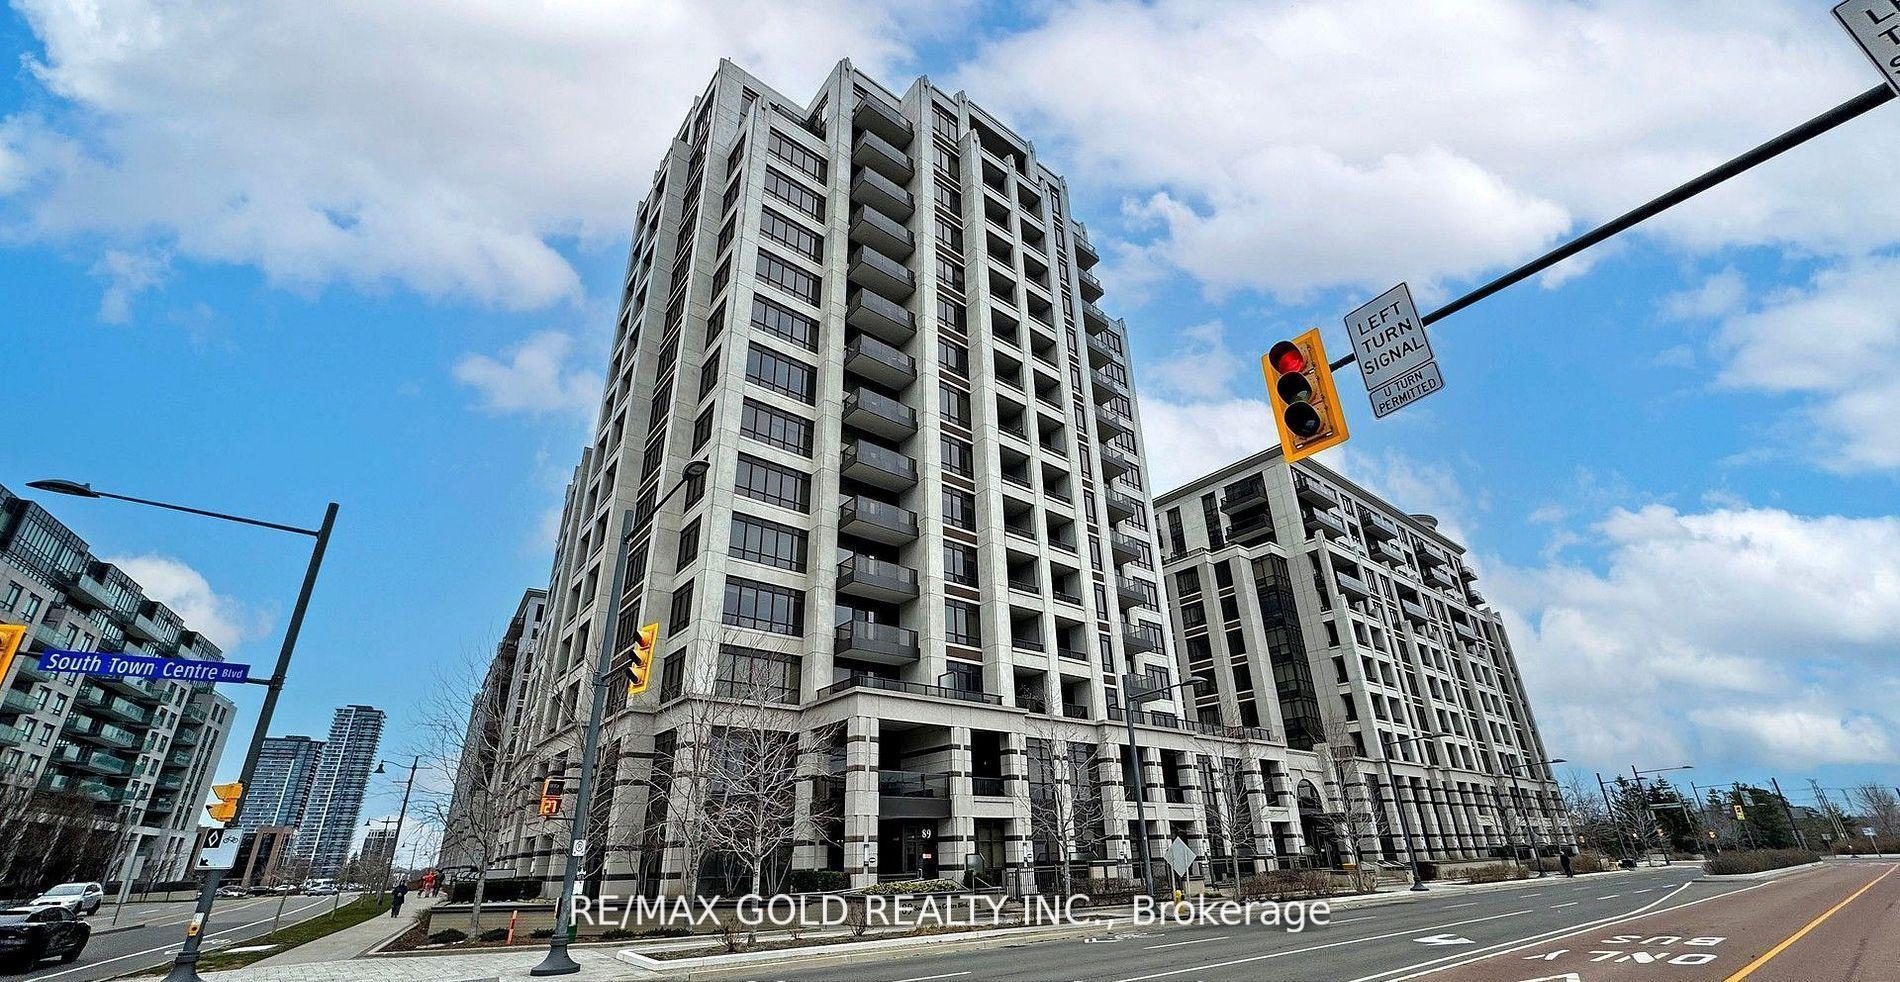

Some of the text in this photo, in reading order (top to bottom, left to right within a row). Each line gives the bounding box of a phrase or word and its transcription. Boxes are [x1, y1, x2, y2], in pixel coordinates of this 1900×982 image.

[1357, 301, 1400, 336] LEFT
[1361, 318, 1412, 353] TURN
[1364, 337, 1424, 375] SIGNAL
[1378, 379, 1436, 414] PERMITTED
[1383, 371, 1423, 397] U TURN
[46, 654, 243, 679] South Town Centre Blvd
[1601, 935, 1727, 946] BUS
[1522, 949, 1718, 965] ONLY
